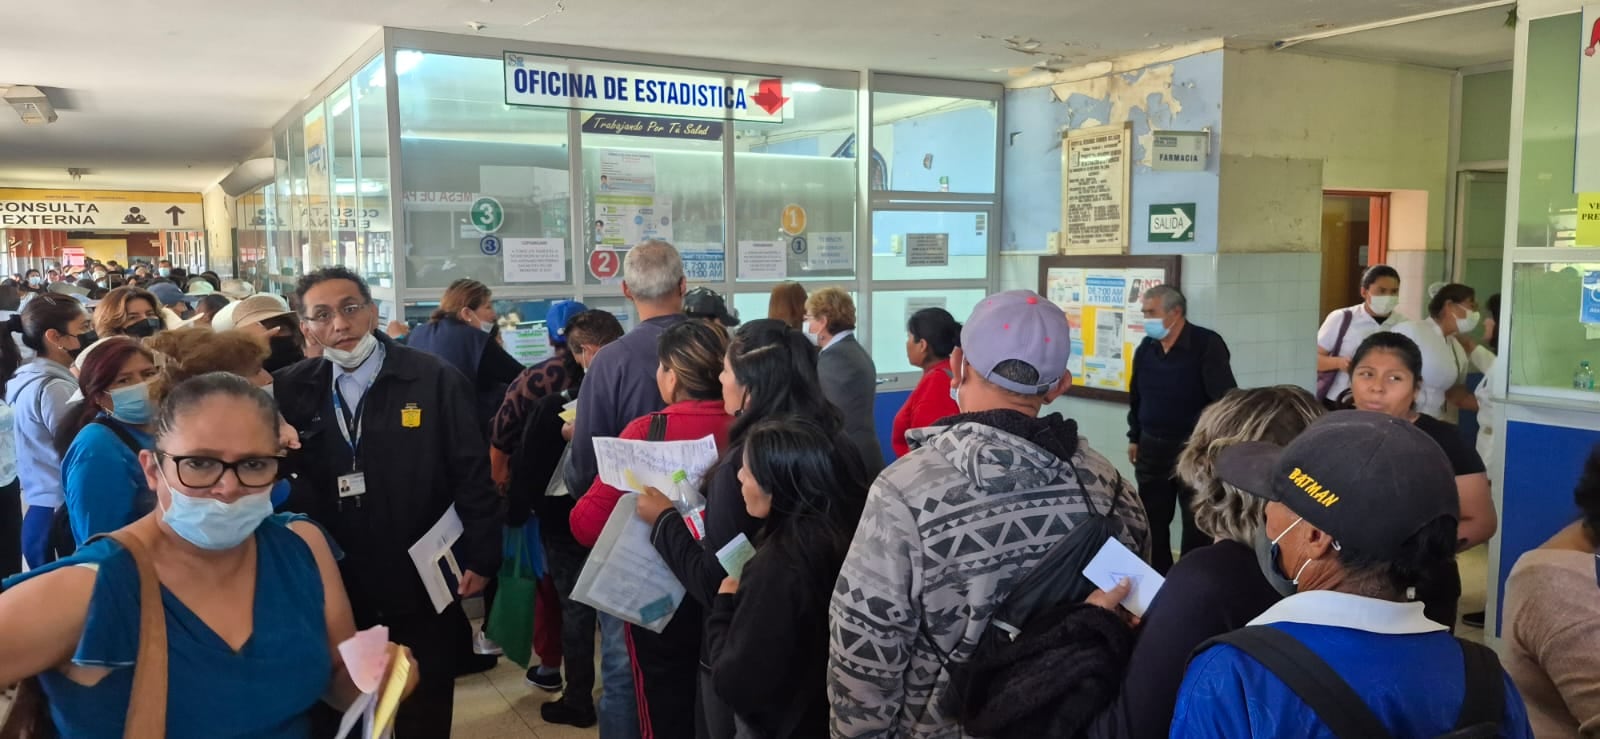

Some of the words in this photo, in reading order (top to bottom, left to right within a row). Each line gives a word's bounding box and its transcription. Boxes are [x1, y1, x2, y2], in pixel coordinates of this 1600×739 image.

[514, 68, 598, 99] OFICINA
[604, 76, 629, 102] DE
[635, 79, 747, 110] ESTADISTICA
[593, 117, 643, 134] Trabajando
[647, 120, 665, 132] Por
[685, 123, 709, 135] Salud
[1159, 153, 1198, 162] FARMACIA
[0, 202, 100, 213] ONSULTA
[480, 203, 495, 224] 3
[2, 214, 96, 225] EXTERNA
[789, 209, 798, 228] 1
[1154, 217, 1184, 230] SALIDA
[485, 239, 497, 252] 3
[796, 240, 802, 251] 1
[598, 253, 612, 273] 2
[691, 262, 708, 270] 7:00
[709, 262, 723, 270] AM
[709, 270, 723, 278] AM
[1098, 287, 1111, 295] 7:00
[1111, 288, 1123, 296] AM
[1094, 295, 1111, 303] 11:00
[1111, 296, 1123, 304] AM
[1288, 467, 1340, 507] BATMAN
